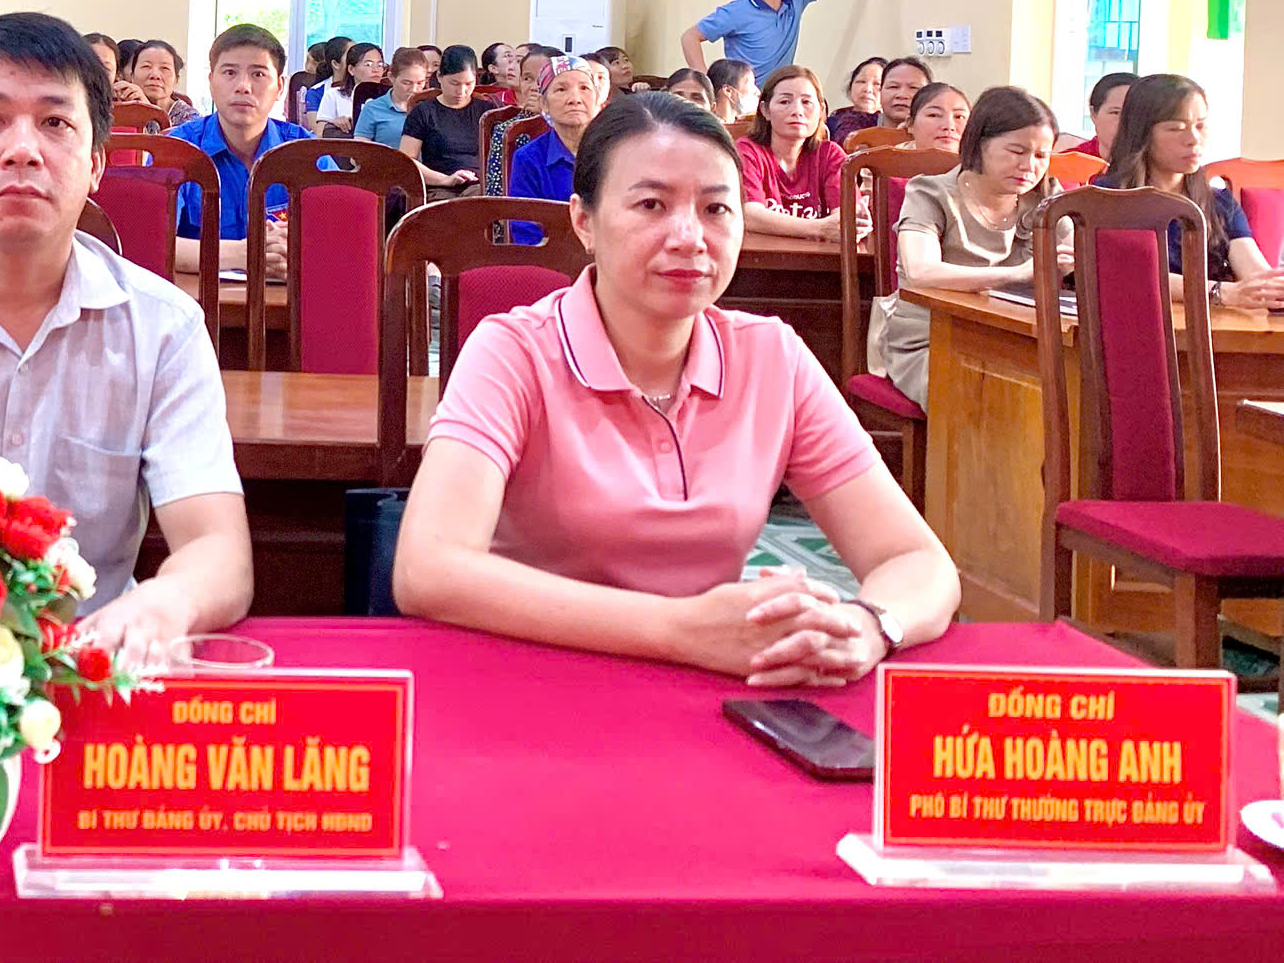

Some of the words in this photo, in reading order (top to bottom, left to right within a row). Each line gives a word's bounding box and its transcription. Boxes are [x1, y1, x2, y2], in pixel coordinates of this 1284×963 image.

[239, 696, 276, 725] CHÍ
[1069, 689, 1116, 721] CHÍ
[83, 734, 197, 790] HOÀNG
[206, 735, 274, 791] VĂN
[283, 735, 371, 792] LĂNG
[933, 723, 996, 780] HỨA
[1003, 728, 1110, 782] HOÀNG
[1118, 739, 1183, 784] ANH
[102, 807, 141, 830] THƯ
[948, 791, 968, 819] BÍ
[972, 793, 1010, 821] THƯ
